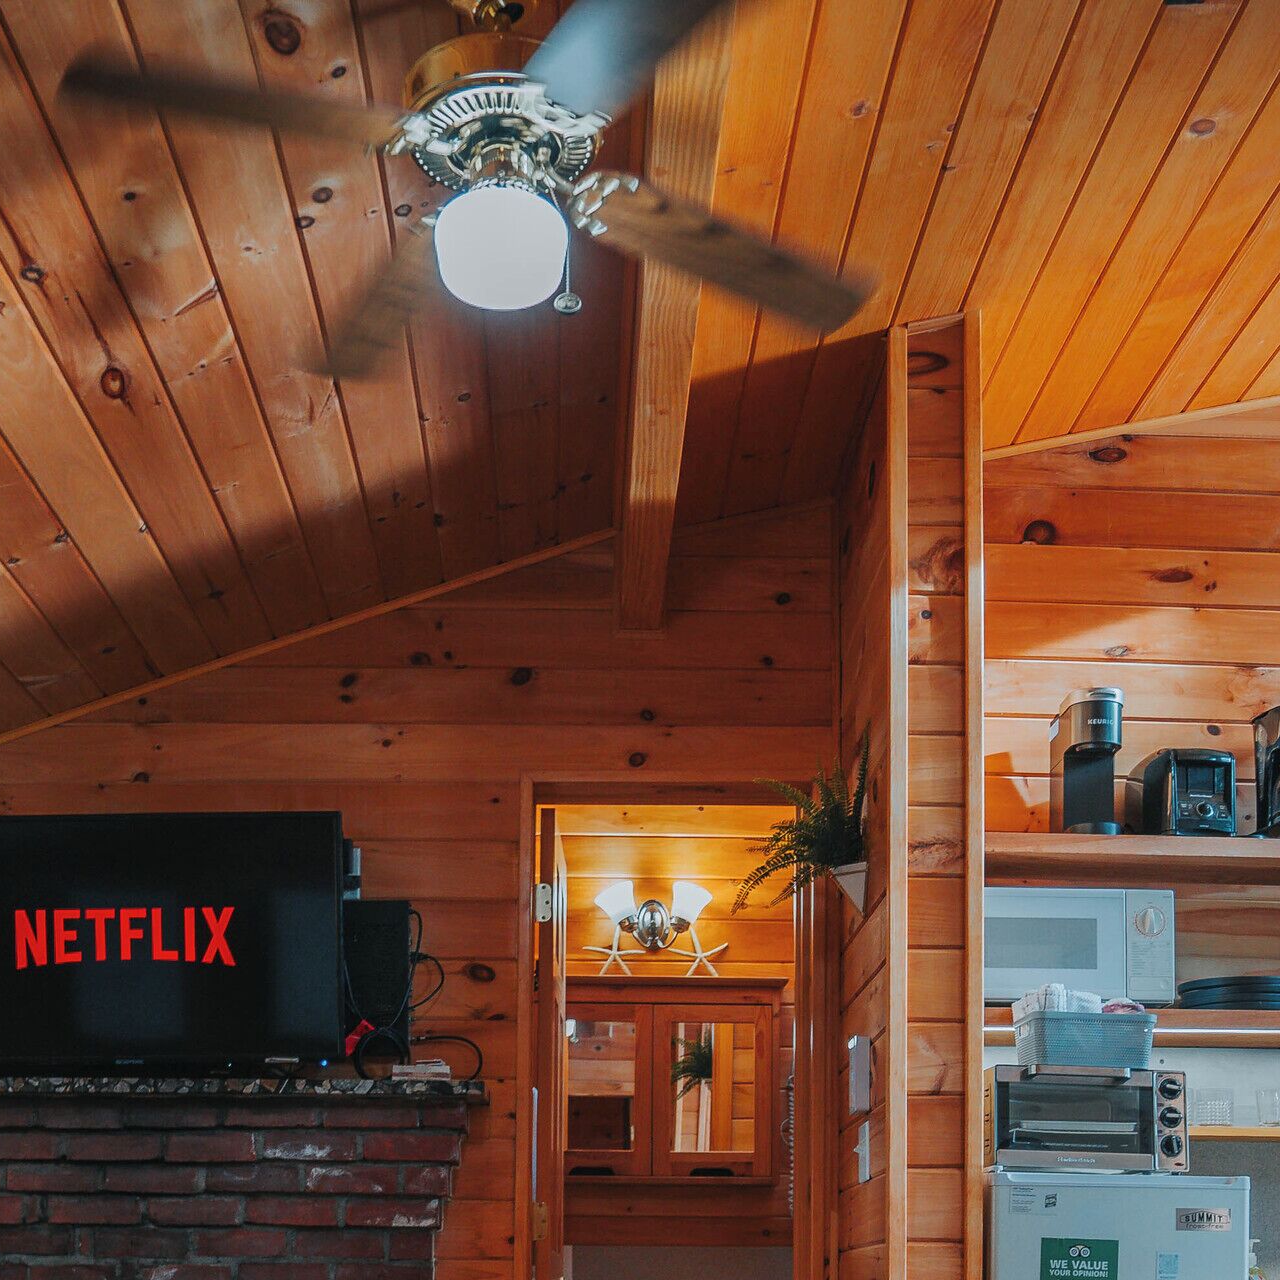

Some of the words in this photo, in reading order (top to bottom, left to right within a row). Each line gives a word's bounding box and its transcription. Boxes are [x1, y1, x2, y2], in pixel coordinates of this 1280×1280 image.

[15, 907, 237, 969] NETFLIX
[1184, 1212, 1223, 1223] SUMMIT
[1050, 1259, 1068, 1269] WE
[1072, 1260, 1109, 1270] VALUE
[1049, 1269, 1071, 1277] YOUR
[1072, 1270, 1109, 1278] OPINION!
